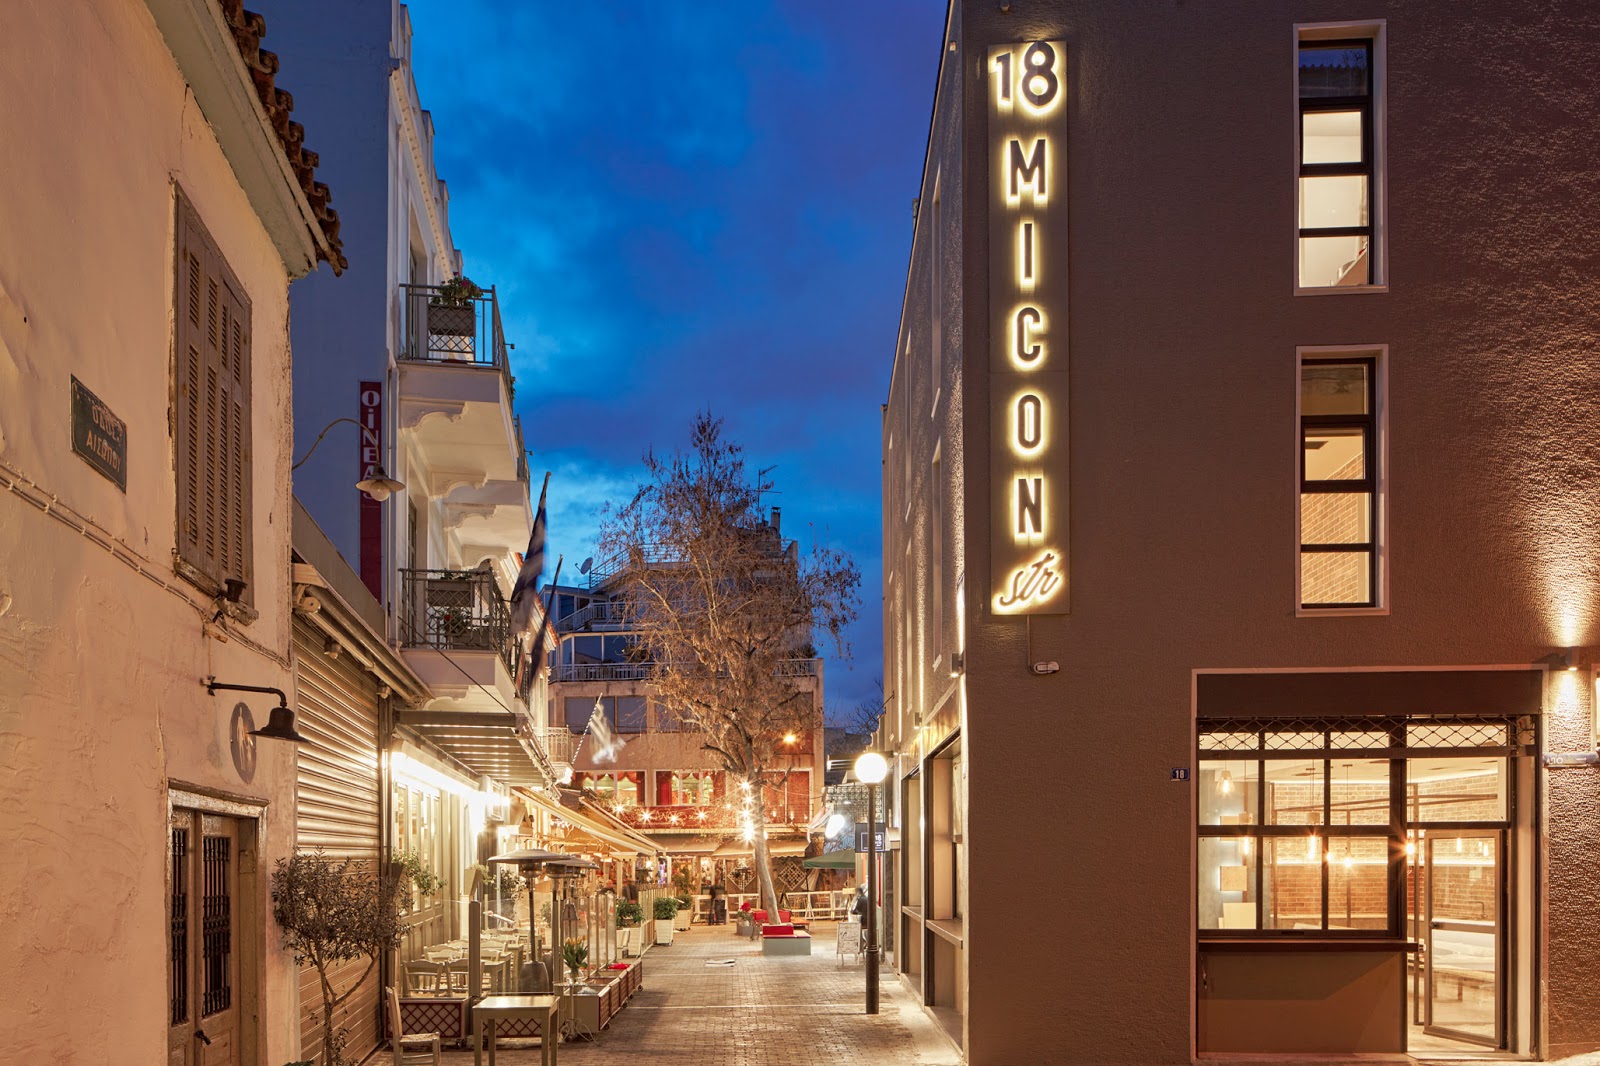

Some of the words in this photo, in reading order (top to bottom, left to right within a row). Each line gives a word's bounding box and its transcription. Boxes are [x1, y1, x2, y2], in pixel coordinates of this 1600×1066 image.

[996, 41, 1058, 107] 18
[1009, 139, 1046, 534] MICON
[1175, 769, 1185, 779] 18
